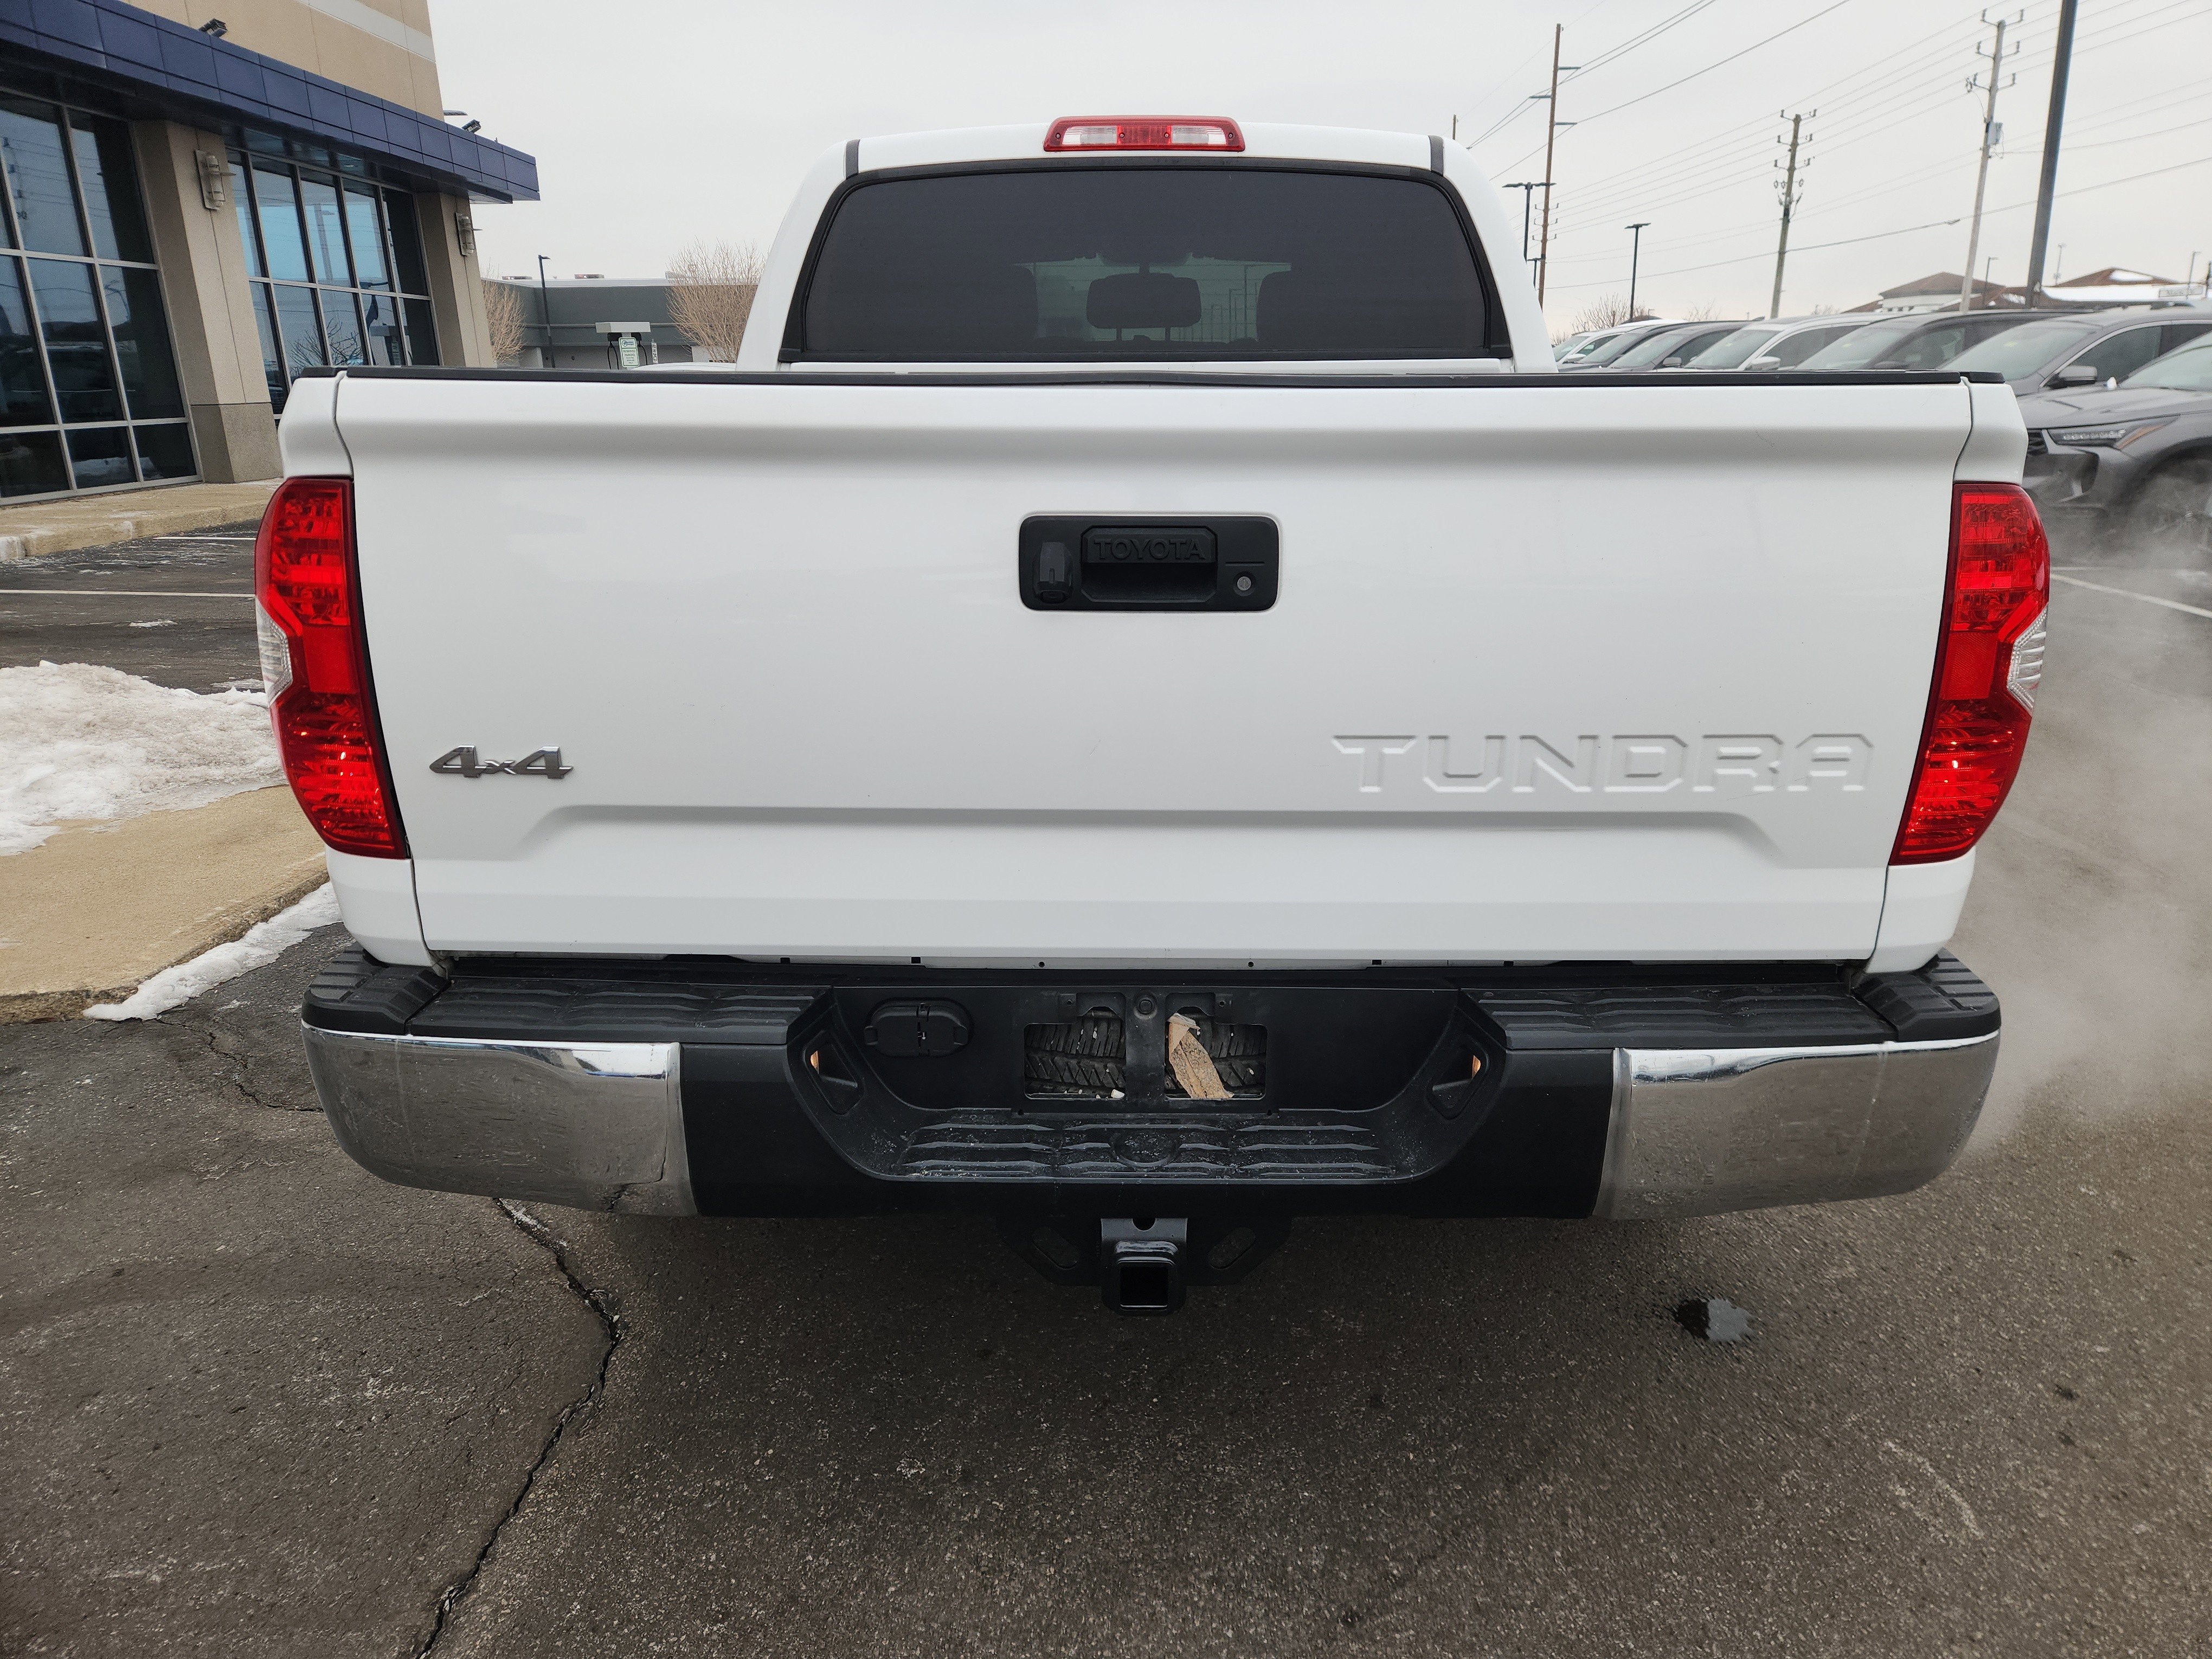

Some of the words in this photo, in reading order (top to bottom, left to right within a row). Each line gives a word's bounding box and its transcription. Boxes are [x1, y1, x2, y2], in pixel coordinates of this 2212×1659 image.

[1093, 538, 1206, 560] TOYOTA
[429, 744, 574, 779] 4x4
[1332, 733, 1874, 793] TUNDRA
